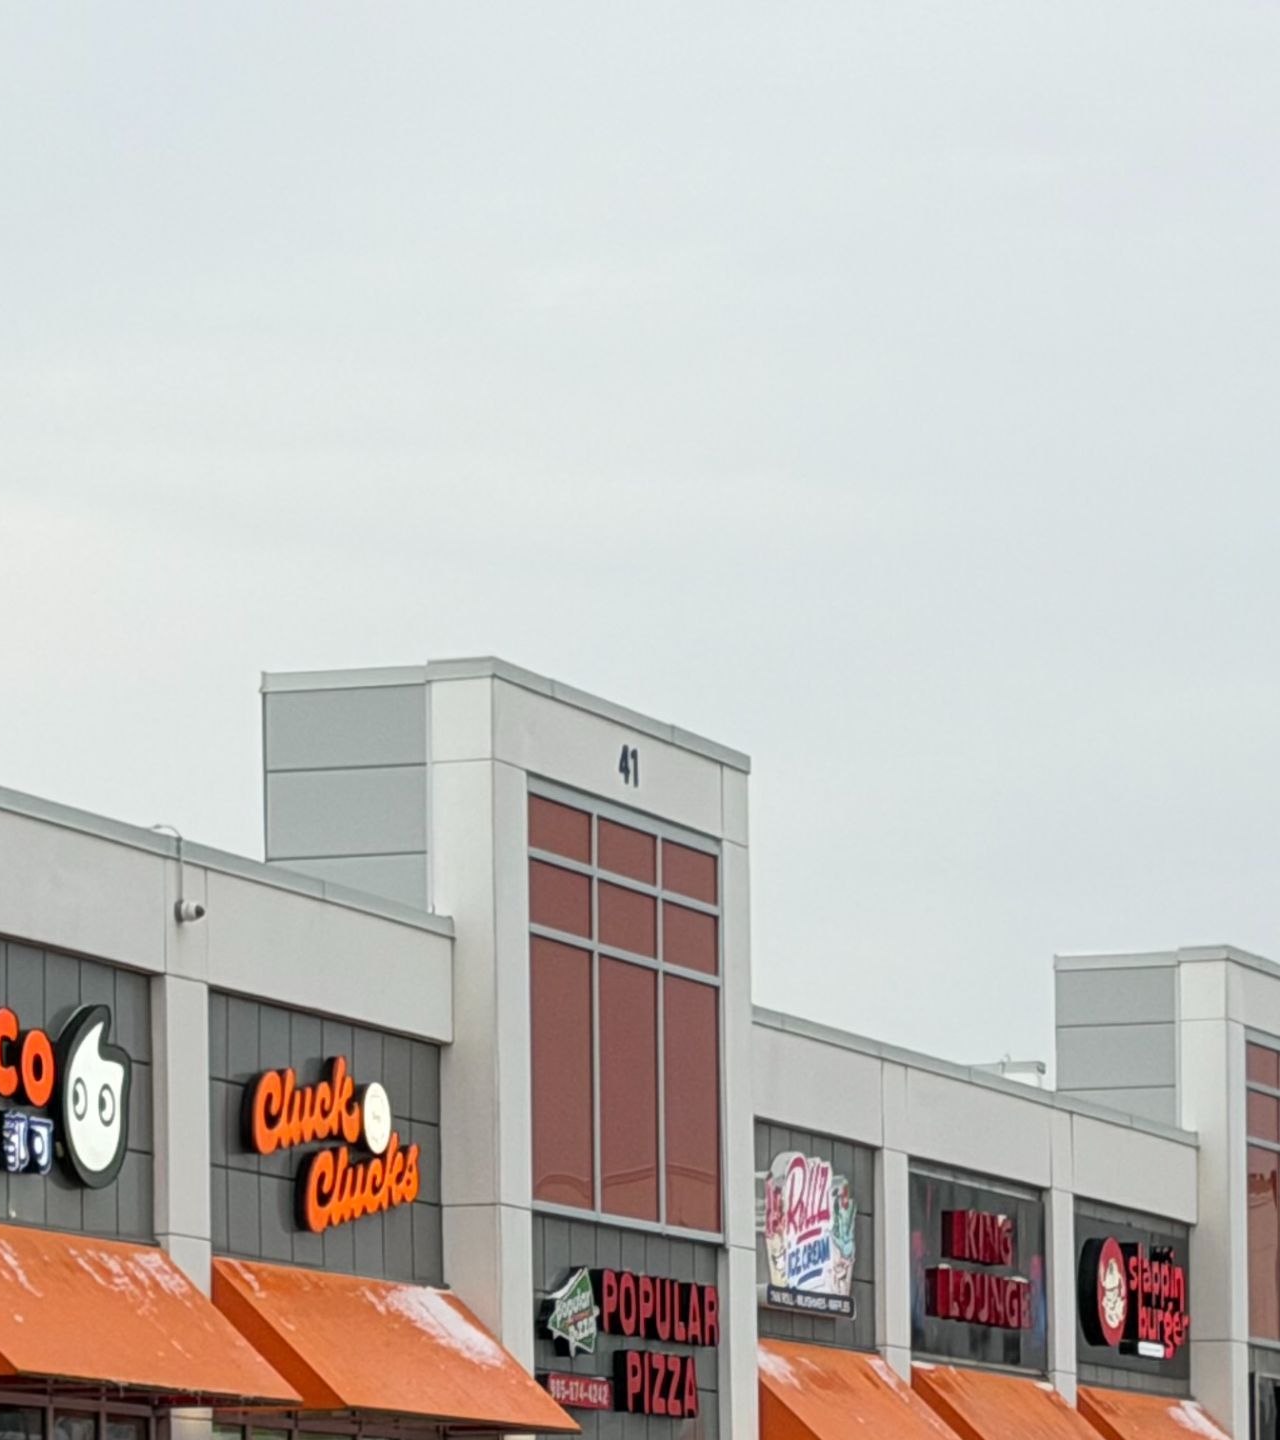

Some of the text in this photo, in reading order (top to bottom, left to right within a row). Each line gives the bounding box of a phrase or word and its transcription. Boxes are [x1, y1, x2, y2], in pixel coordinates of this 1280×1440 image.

[618, 744, 639, 788] 41
[252, 1055, 362, 1155] Cluck
[305, 1131, 419, 1235] Clucks
[963, 1210, 1013, 1267] KING
[602, 1267, 719, 1348] POPULAR
[949, 1269, 1033, 1330] LOUNGE
[1138, 1300, 1192, 1359] burger
[626, 1350, 698, 1418] PIZZA
